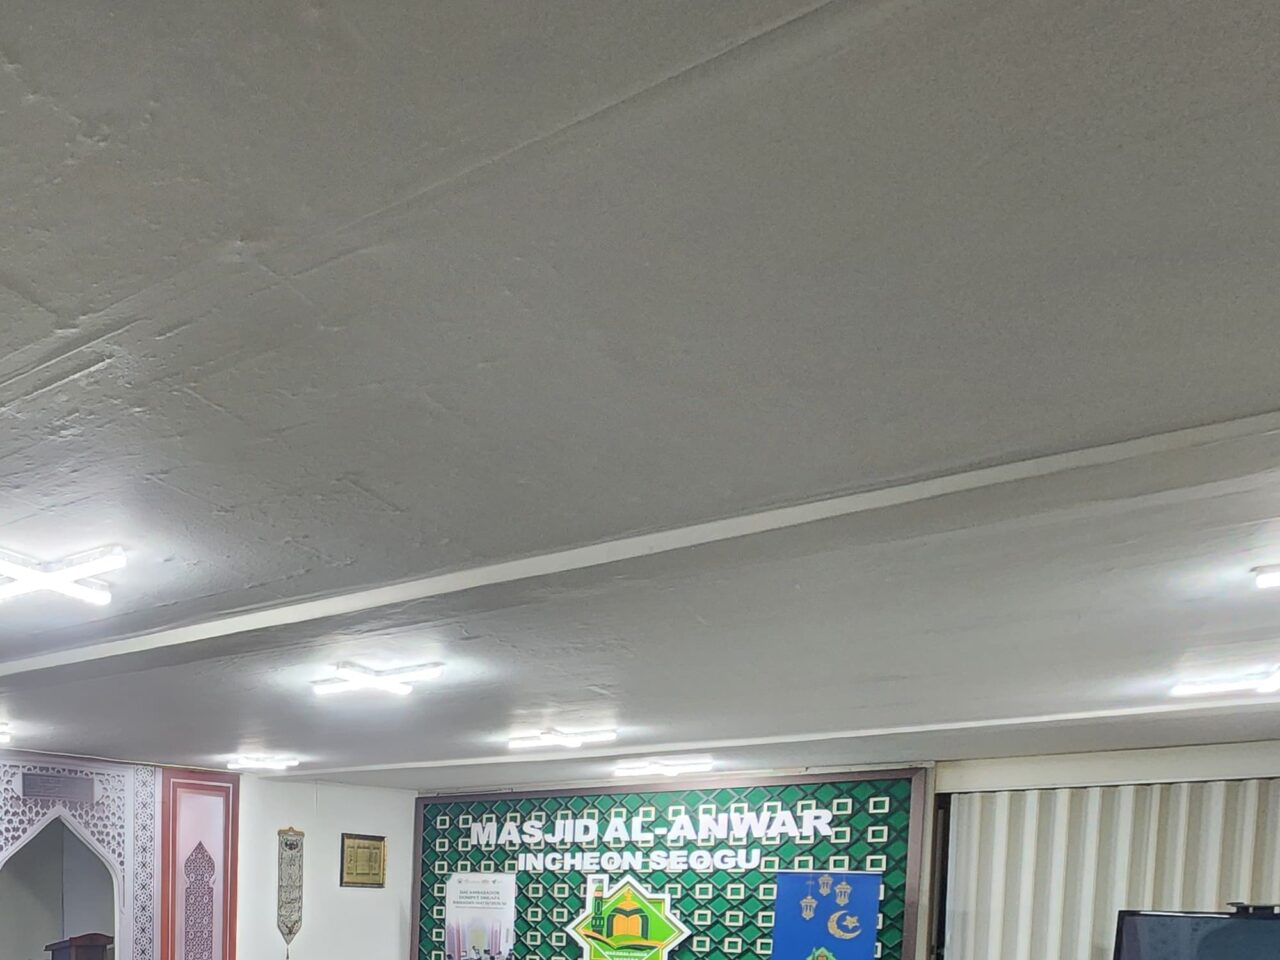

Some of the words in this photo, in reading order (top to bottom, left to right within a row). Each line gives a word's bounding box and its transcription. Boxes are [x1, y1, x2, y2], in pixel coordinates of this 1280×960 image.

[471, 819, 599, 846] MASJID
[602, 809, 833, 842] AL-ANWAR
[519, 851, 643, 871] INCHEON
[650, 849, 761, 870] SEOGU
